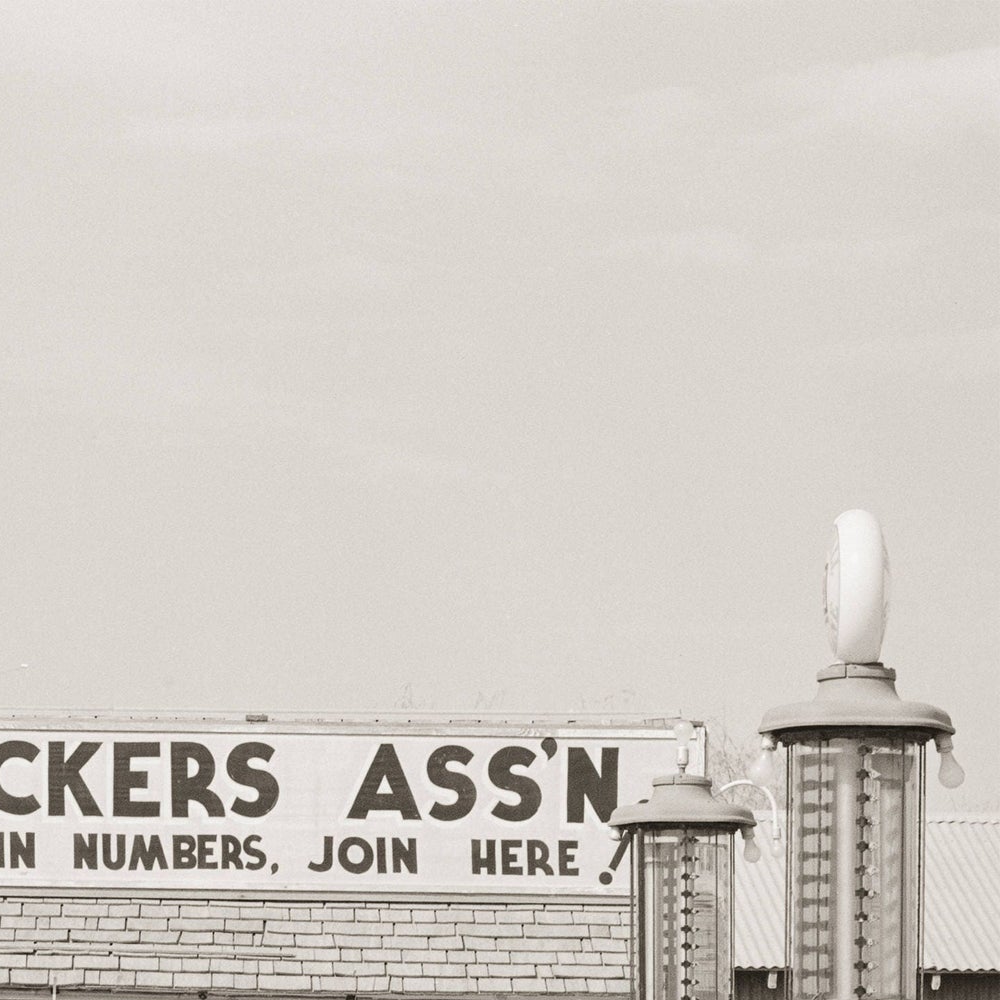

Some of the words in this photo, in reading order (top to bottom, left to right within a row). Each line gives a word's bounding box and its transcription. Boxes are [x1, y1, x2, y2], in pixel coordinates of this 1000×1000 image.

[347, 737, 619, 824] ASS'N
[74, 834, 279, 875] NUMBERS,
[308, 836, 418, 875] JOIN
